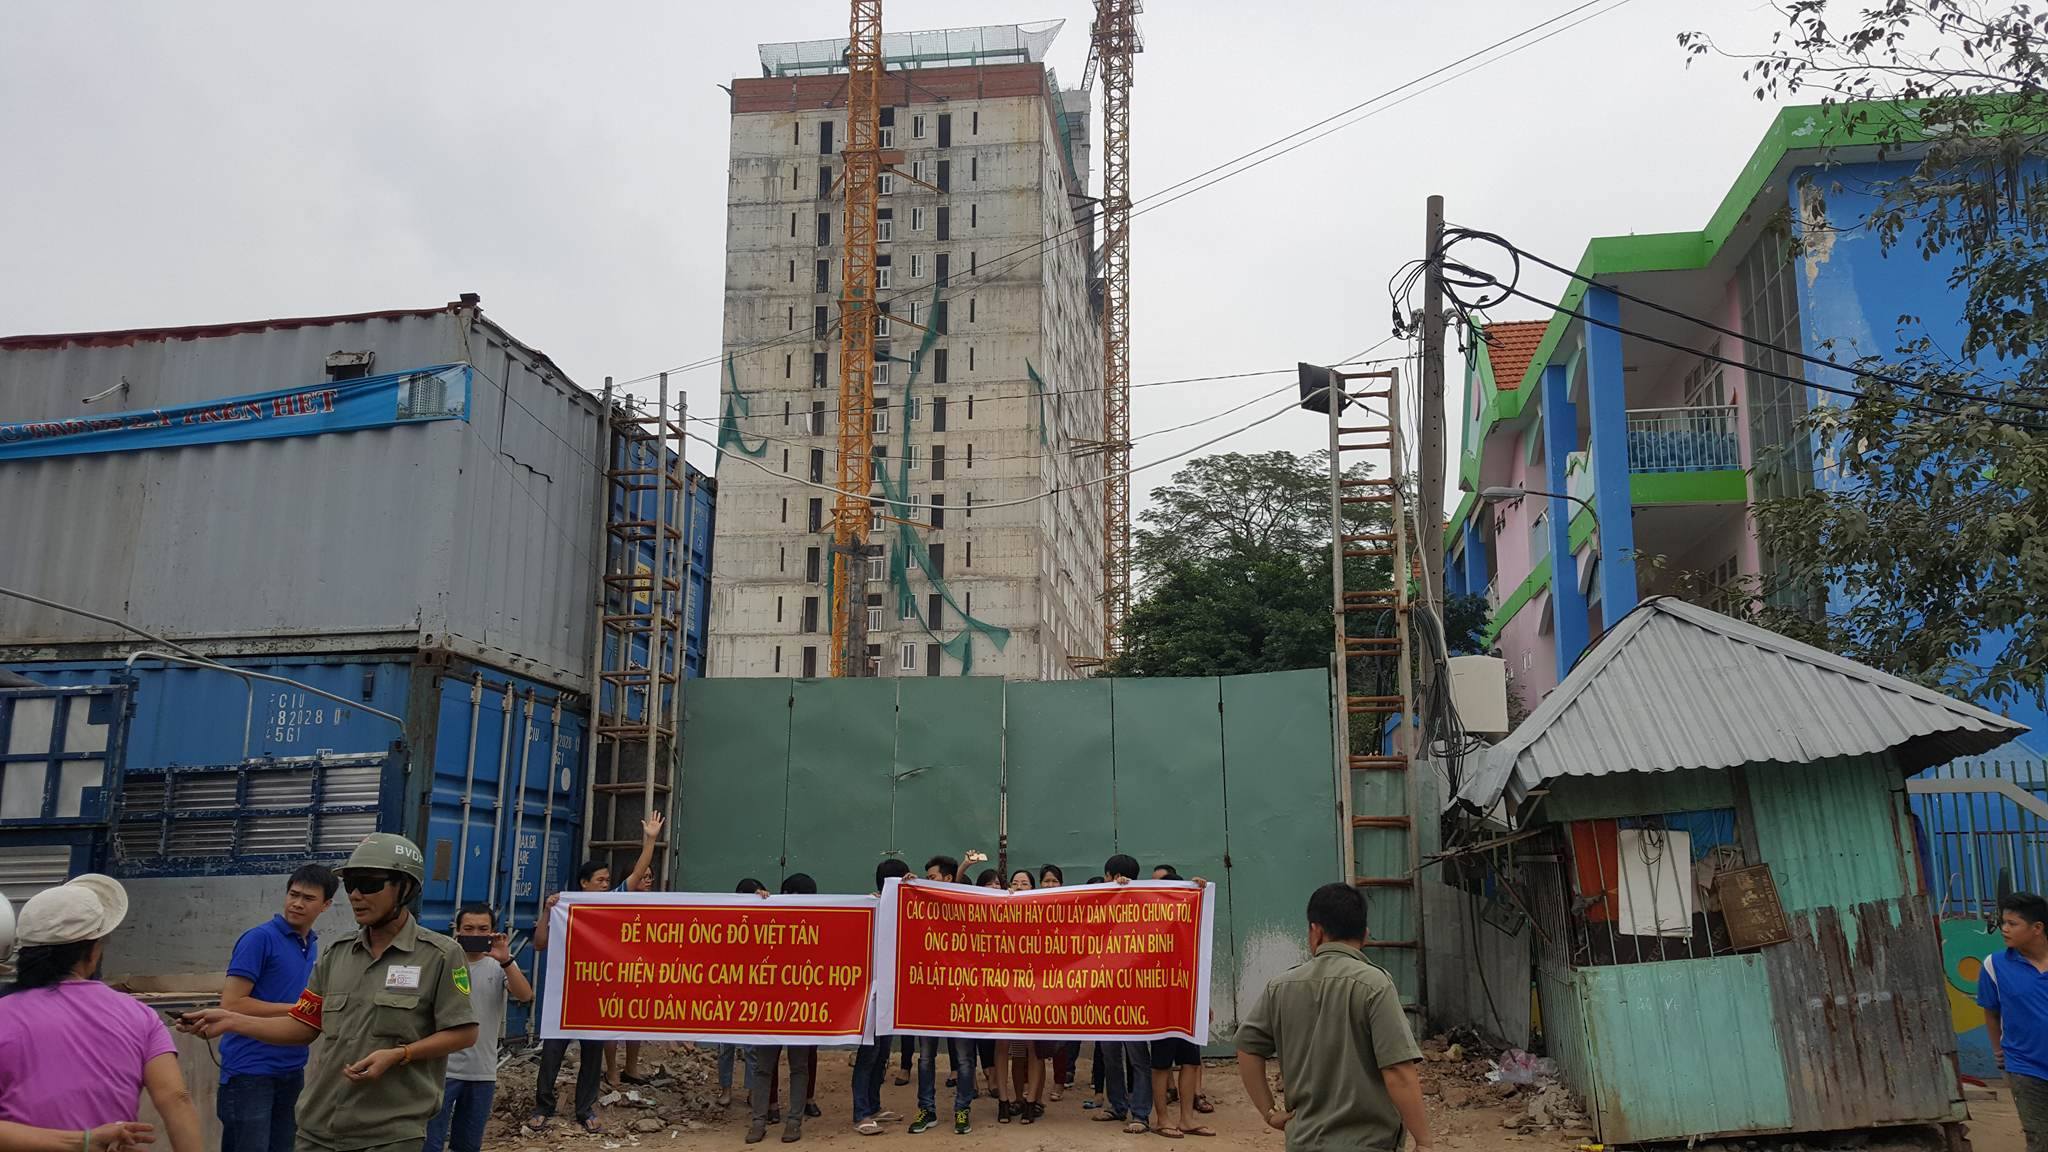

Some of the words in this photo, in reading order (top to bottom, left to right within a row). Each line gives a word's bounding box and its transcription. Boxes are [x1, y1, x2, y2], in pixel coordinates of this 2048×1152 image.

[268, 709, 323, 726] 82028
[906, 896, 925, 920] CÁC
[941, 903, 966, 922] QUAN
[968, 903, 987, 923] BAN
[1025, 900, 1044, 924] HÃY
[1046, 899, 1065, 924] CỨU
[1067, 896, 1085, 924] LẤY
[1087, 899, 1106, 924] DÂN
[1108, 898, 1140, 923] NGHÈO
[1142, 897, 1174, 922] CHÚNG
[621, 913, 641, 945] ĐỀ
[645, 922, 685, 949] NGHỊ
[689, 917, 722, 944] ÔNG
[727, 914, 749, 945] ĐỖ
[753, 917, 786, 950] VIỆT
[789, 918, 819, 945] TÂN
[924, 925, 948, 952] ÔNG
[951, 925, 968, 952] ĐỖ
[970, 929, 992, 957] VIỆT
[994, 929, 1016, 954] TÂN
[1018, 928, 1042, 954] CHỦ
[1044, 927, 1067, 955] ĐẦU
[1070, 934, 1086, 955] TƯ
[1087, 934, 1104, 959] DỰ
[1106, 929, 1121, 954] ÁN
[1123, 928, 1145, 954] TÂN
[1148, 928, 1174, 953] BÌNH
[573, 960, 614, 987] THỰC
[617, 956, 655, 989] HIỆN
[658, 957, 703, 985] ĐÚNG
[707, 963, 744, 985] CAM
[748, 955, 778, 985] KẾT
[780, 958, 824, 991] CUỘC
[828, 965, 862, 992] HỌP
[909, 961, 924, 985] ĐÃ
[926, 960, 946, 991] LẬT
[948, 967, 978, 992] LỌNG
[980, 962, 1010, 988] TRÁO
[1012, 962, 1036, 992] TRỞ,
[1042, 963, 1064, 989] LỪA
[1066, 968, 1089, 993] GẠT
[1090, 963, 1114, 989] DÂN
[1116, 967, 1133, 989] CƯ
[1135, 960, 1169, 988] NHIỀU
[598, 991, 624, 1019] VỚI
[628, 998, 651, 1020] CƯ
[654, 993, 687, 1021] DÂN
[690, 993, 736, 1022] NGÀY
[738, 1000, 833, 1024] 29/10/2016.
[949, 992, 973, 1023] ĐẨY
[975, 998, 999, 1024] DÂN
[1001, 1003, 1017, 1025] CƯ
[1019, 999, 1042, 1025] VÀO
[1044, 1004, 1068, 1025] CON
[1070, 999, 1111, 1026] ĐƯỜNG
[1114, 999, 1149, 1026] CÙNG.
